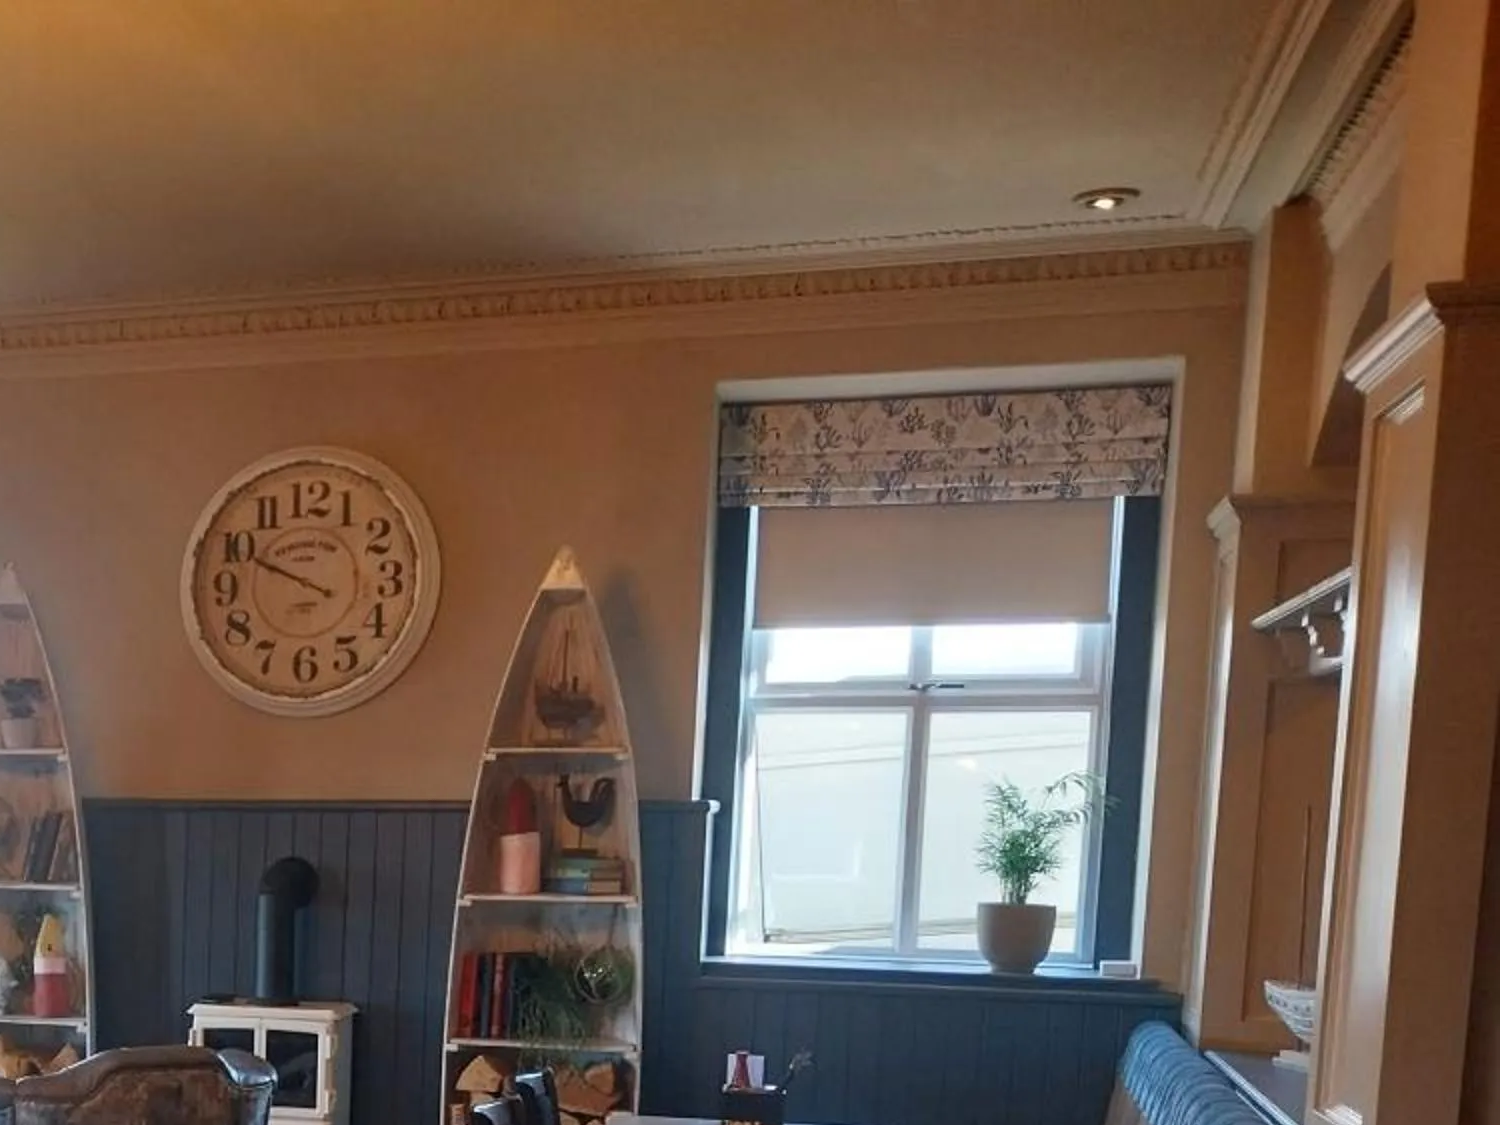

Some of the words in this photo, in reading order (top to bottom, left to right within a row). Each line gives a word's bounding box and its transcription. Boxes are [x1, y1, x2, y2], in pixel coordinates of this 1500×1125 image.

[254, 496, 282, 530] 11
[288, 480, 331, 519] 12
[339, 490, 356, 528] 1
[223, 530, 255, 564] 10
[365, 517, 392, 556] 2
[213, 570, 238, 607] 9
[377, 560, 402, 598] 3
[225, 609, 251, 647] 8
[362, 602, 388, 638] 4
[255, 639, 276, 675] 7
[292, 645, 318, 683] 6
[333, 635, 358, 673] 5
